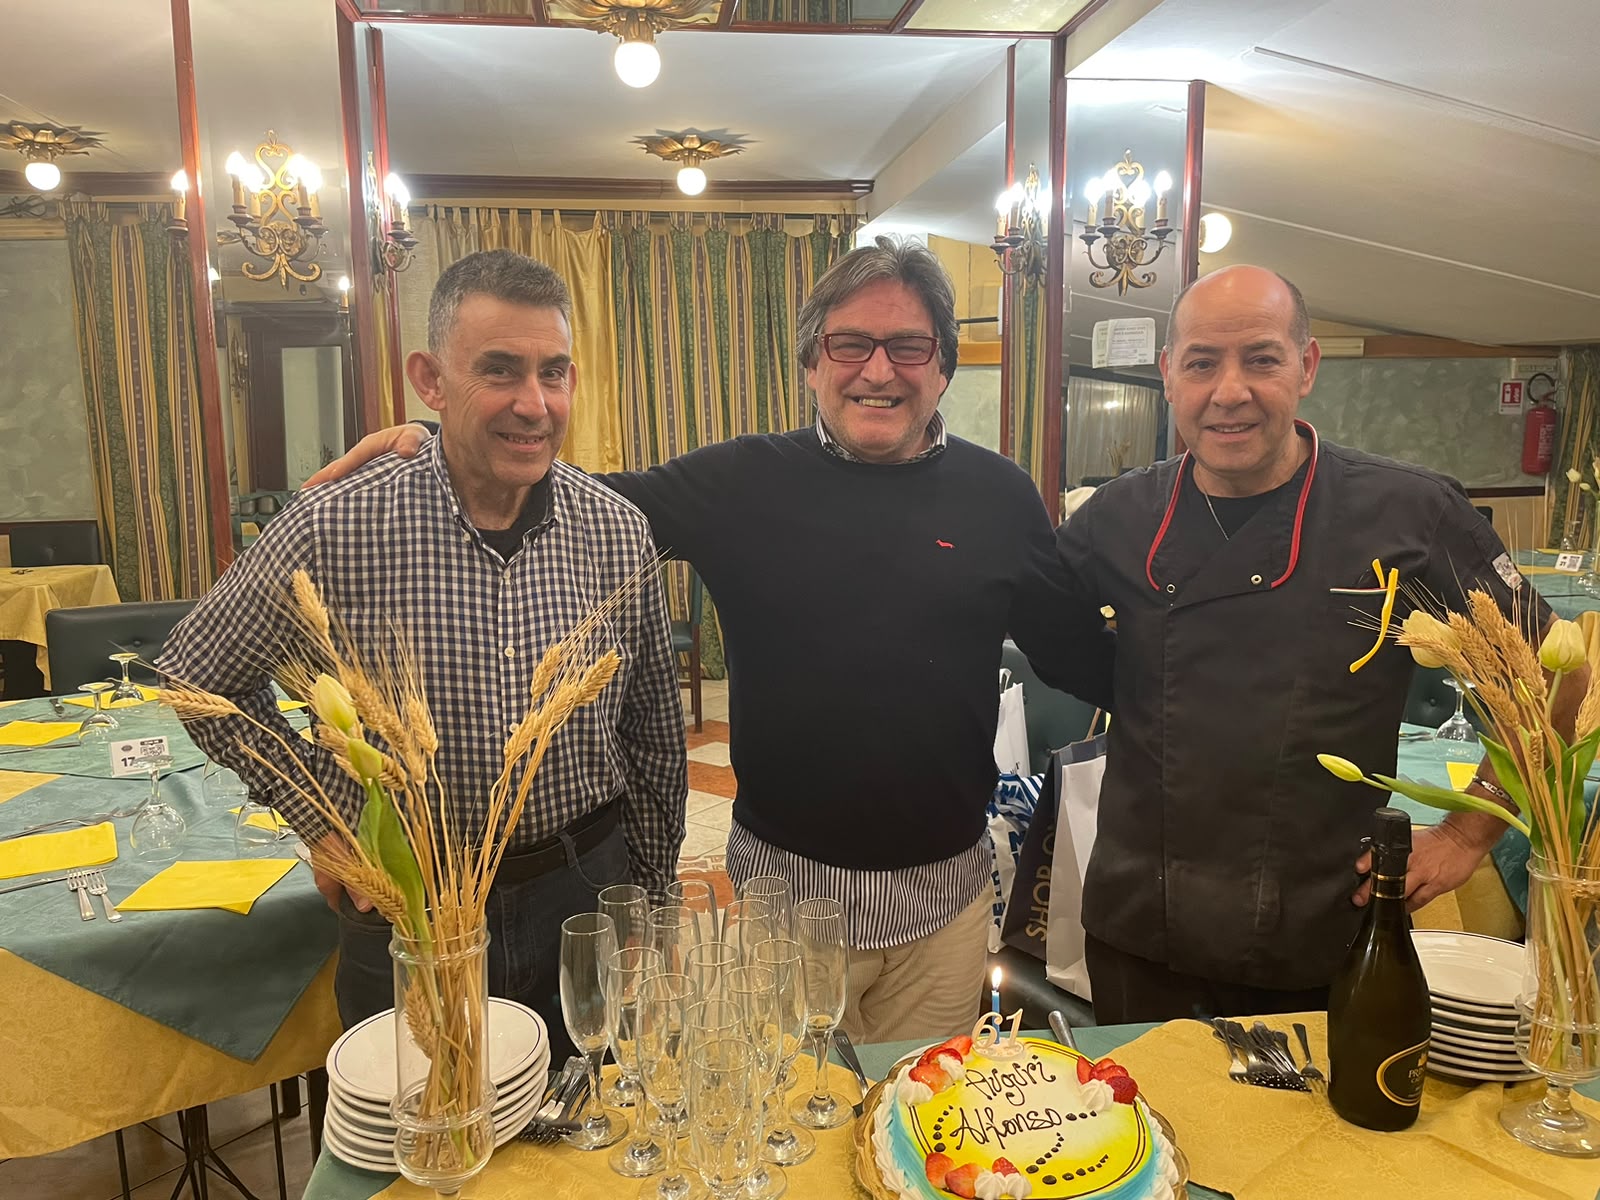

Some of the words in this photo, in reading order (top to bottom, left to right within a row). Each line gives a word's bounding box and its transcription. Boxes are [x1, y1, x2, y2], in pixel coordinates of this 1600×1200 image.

[121, 756, 136, 767] 17
[1025, 865, 1051, 942] SHOP
[971, 1008, 1024, 1048] 61
[965, 1054, 1057, 1106] Auguri
[949, 1106, 1062, 1150] Alfonso
